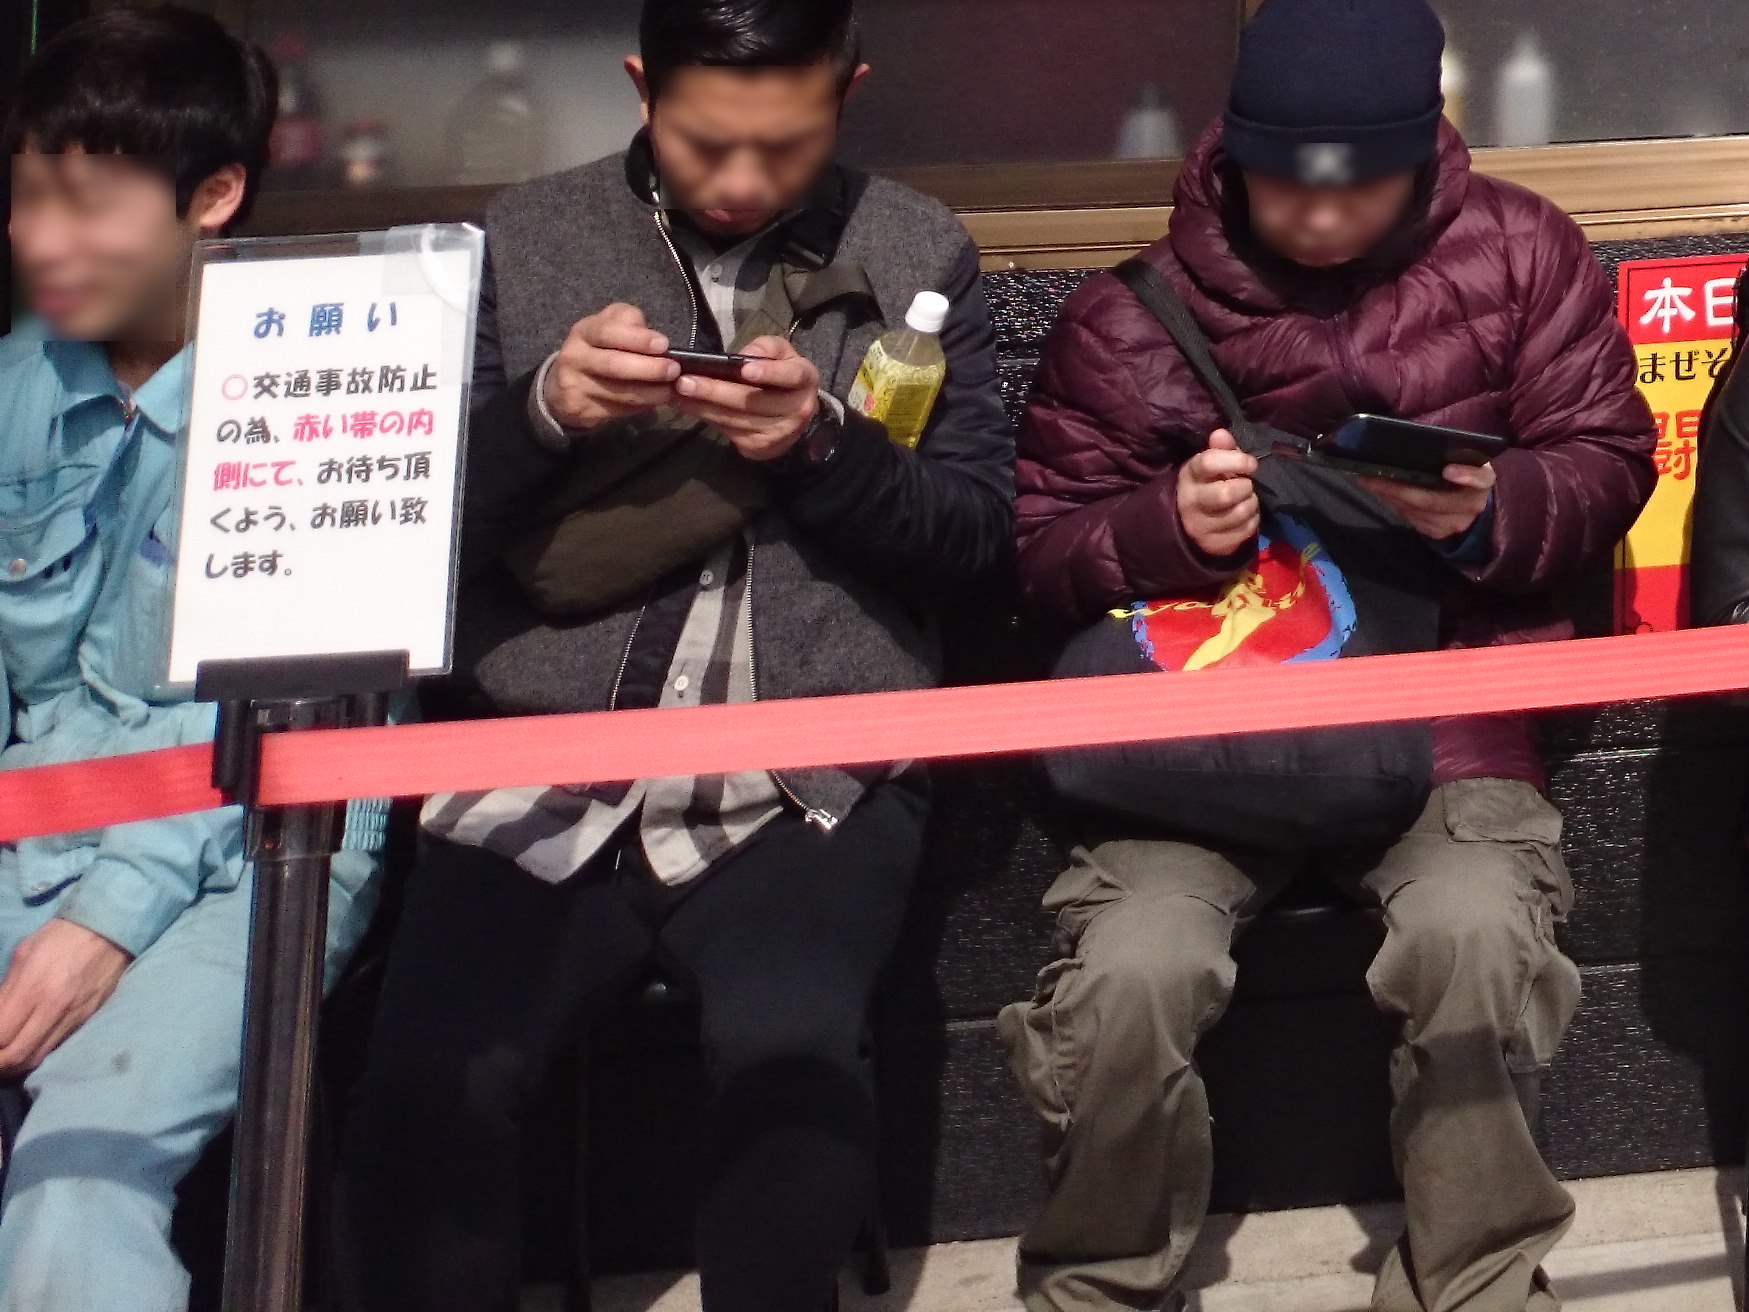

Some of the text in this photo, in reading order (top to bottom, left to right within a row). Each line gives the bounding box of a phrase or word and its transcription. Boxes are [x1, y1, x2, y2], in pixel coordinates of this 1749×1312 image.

[253, 301, 398, 339] お願い
[216, 408, 434, 445] の為、赤い帯の内
[213, 450, 432, 492] 側にて、お待ち頂
[209, 496, 428, 534] くよう、お願い致
[204, 548, 293, 579] します。
